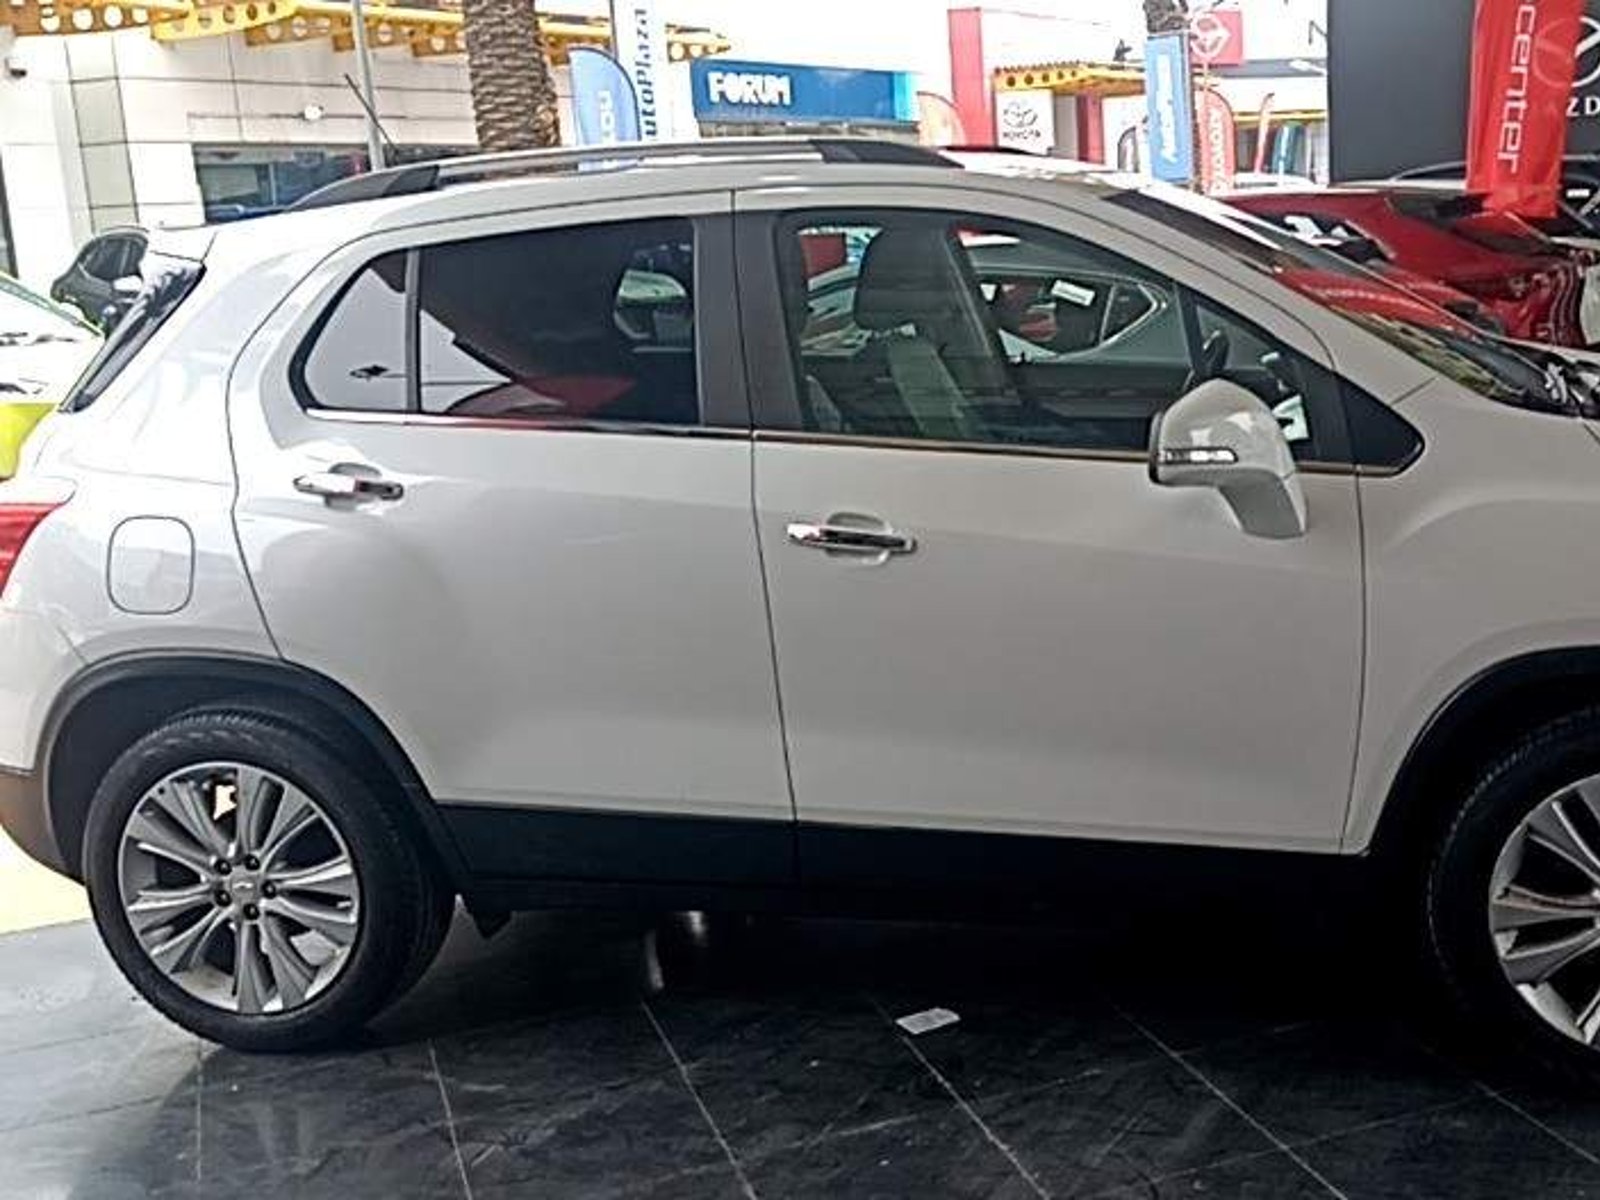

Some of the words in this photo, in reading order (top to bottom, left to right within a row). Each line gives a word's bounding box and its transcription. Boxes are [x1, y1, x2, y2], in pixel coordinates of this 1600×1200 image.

[634, 8, 658, 138] utoPlaza
[708, 72, 791, 106] FORUM
[1497, 0, 1536, 174] center
